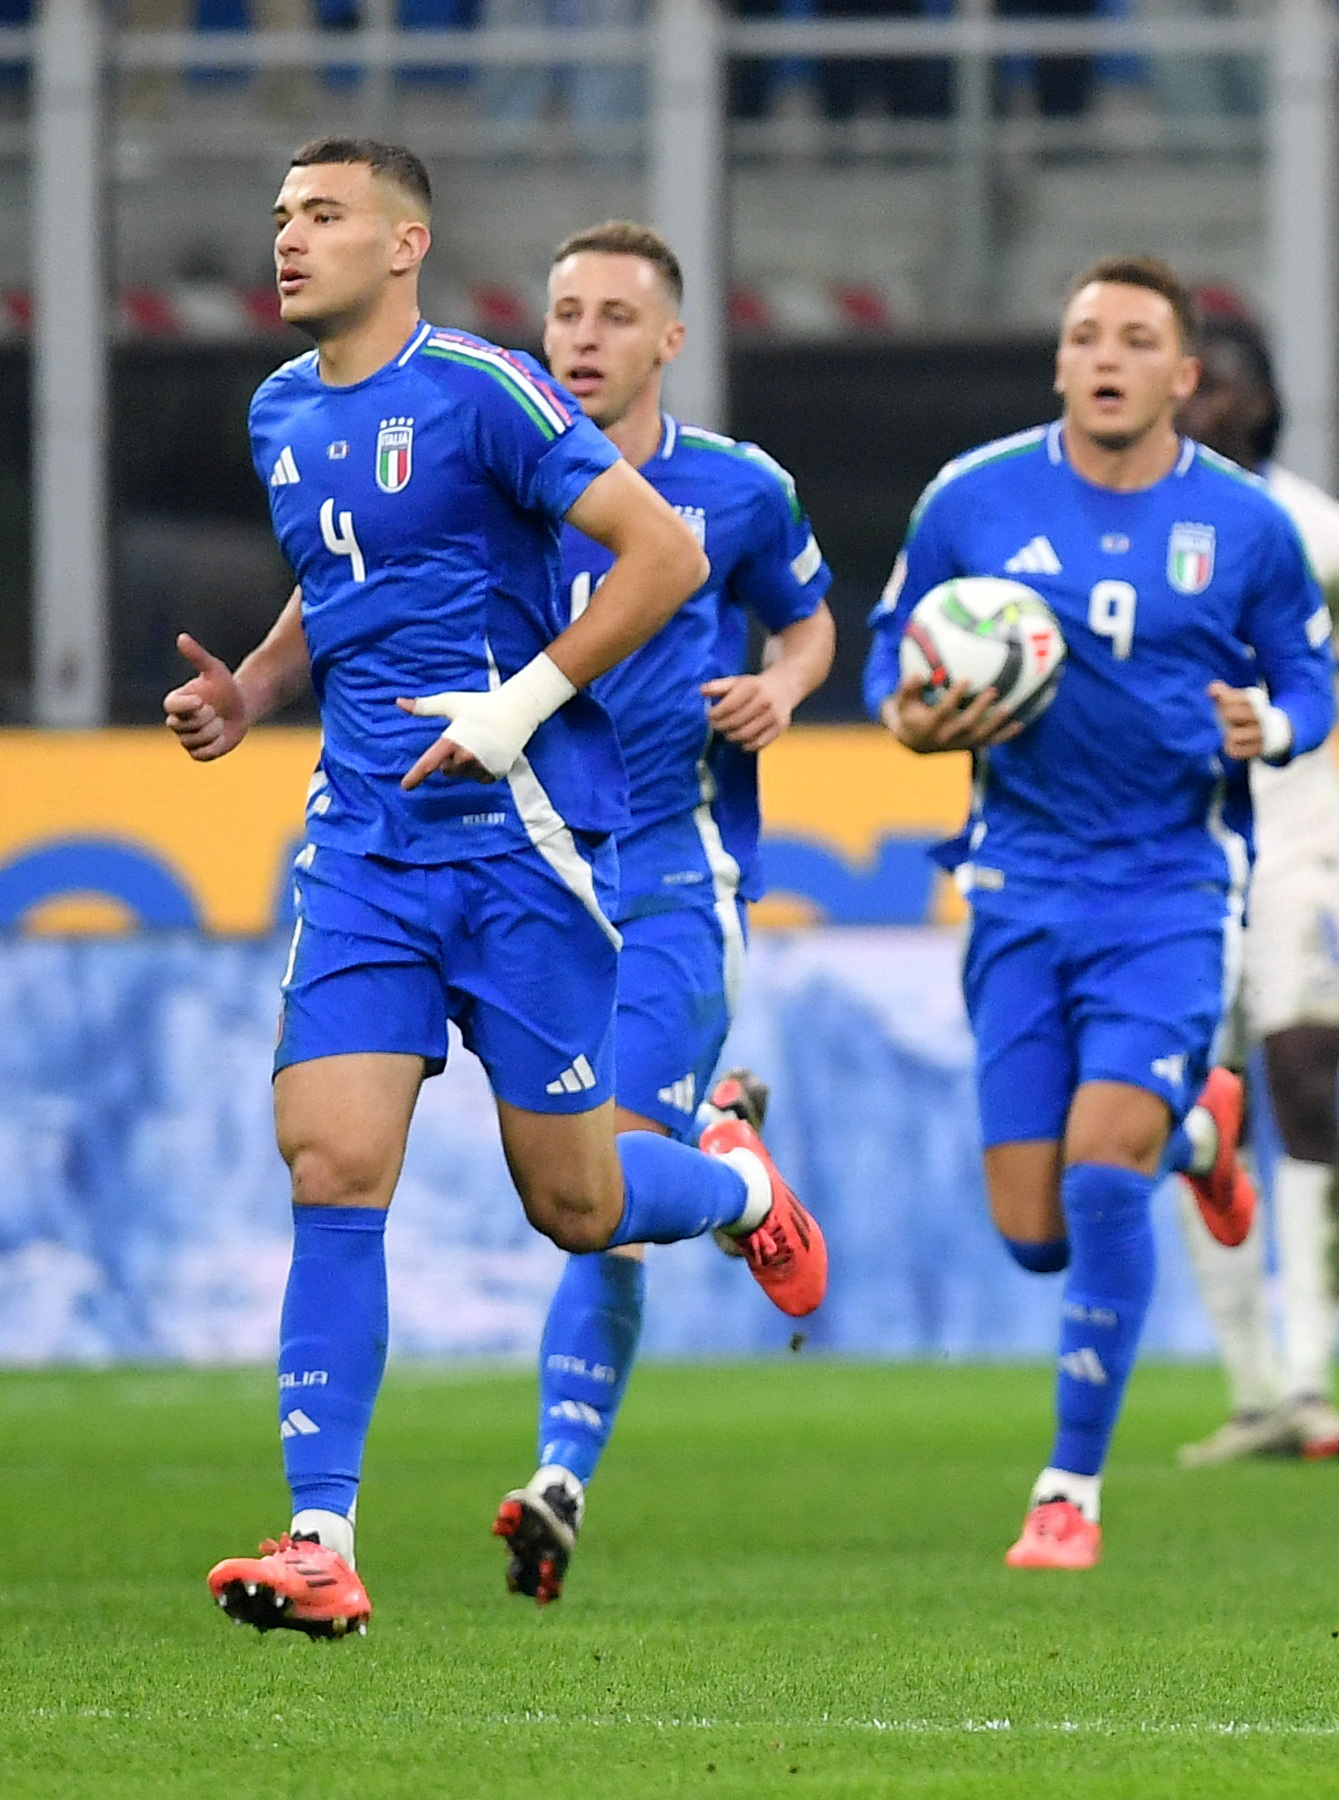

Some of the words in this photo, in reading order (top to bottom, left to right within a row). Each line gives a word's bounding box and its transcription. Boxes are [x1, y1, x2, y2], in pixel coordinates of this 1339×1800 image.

[319, 497, 366, 583] 4
[1087, 579, 1138, 661] 9
[279, 1370, 329, 1388] ALIA
